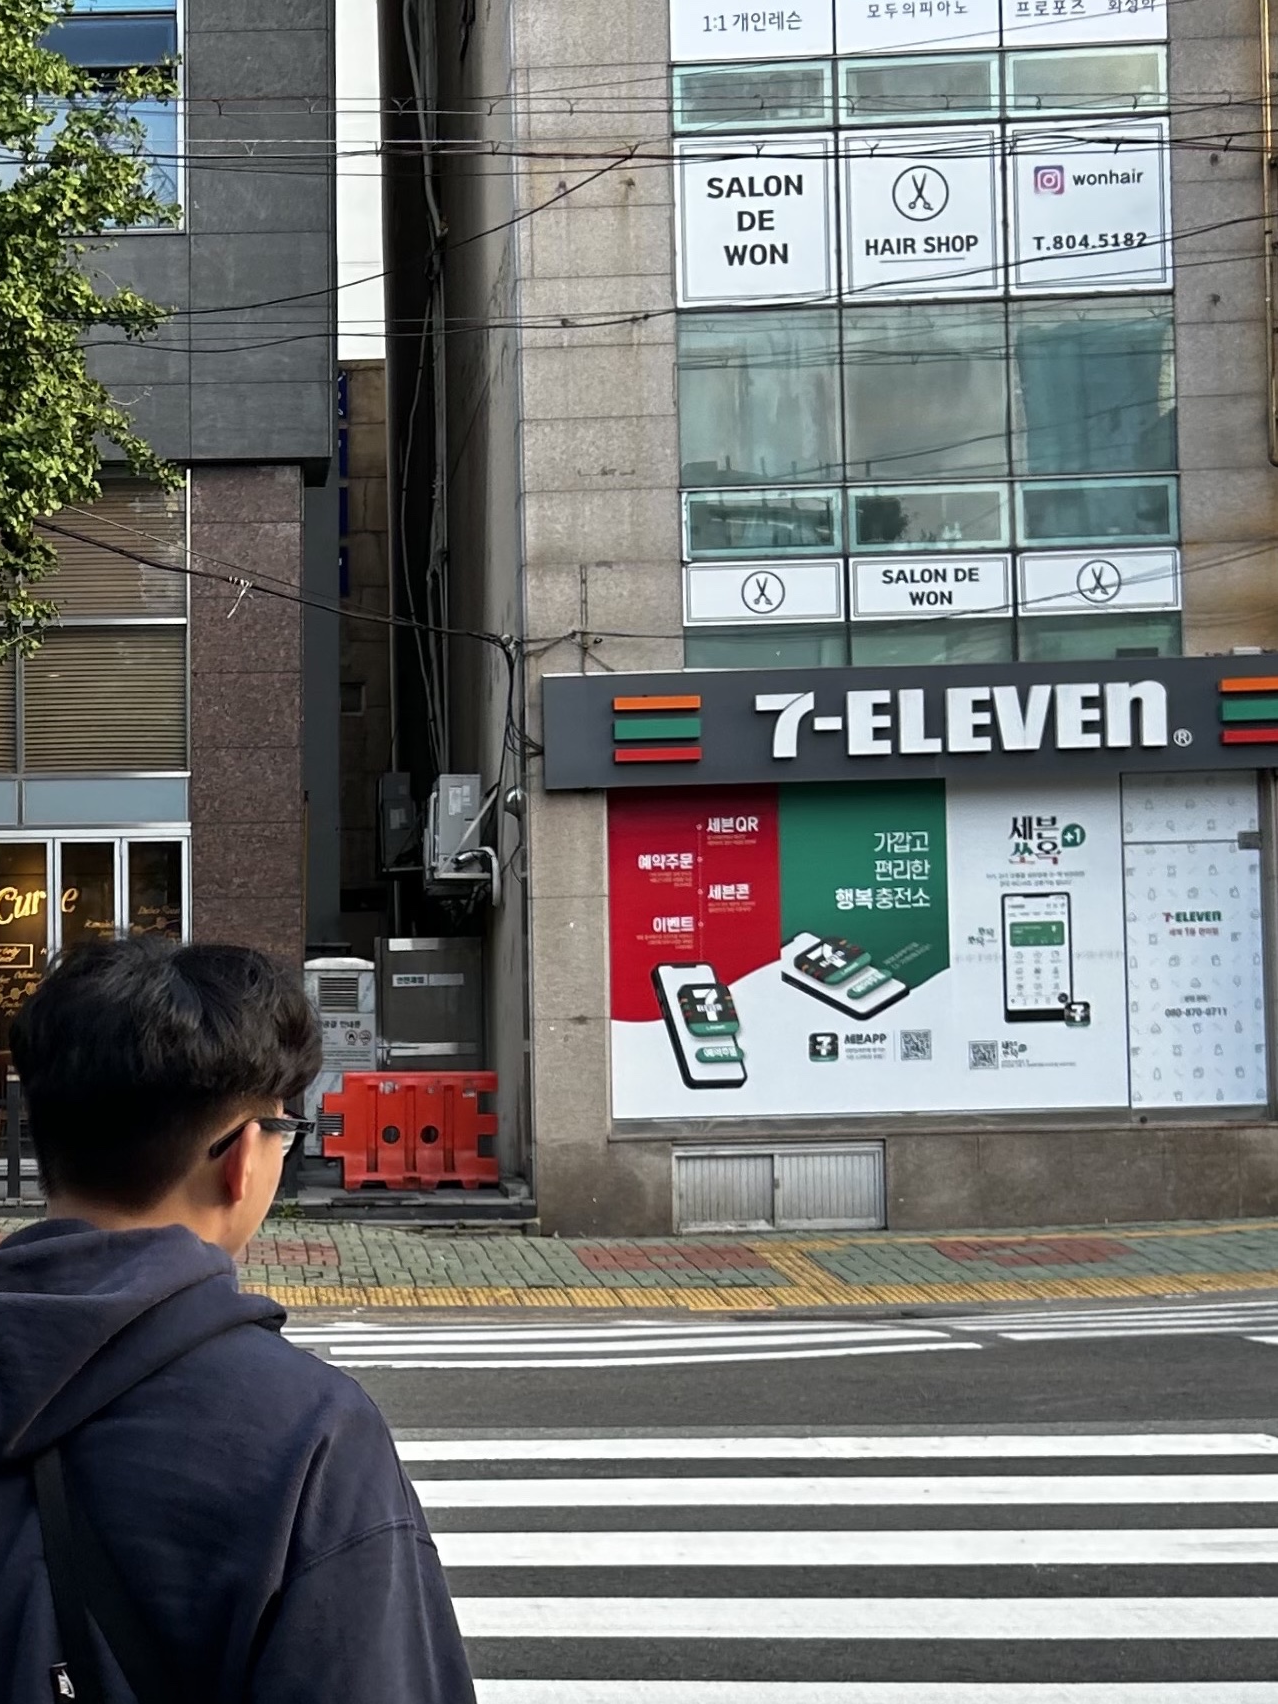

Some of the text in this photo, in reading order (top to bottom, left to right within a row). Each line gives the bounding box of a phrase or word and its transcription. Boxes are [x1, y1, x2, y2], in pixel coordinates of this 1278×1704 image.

[867, 0, 968, 19] 모두의피아노
[702, 11, 803, 32] 1:1 개인레슨
[706, 174, 804, 199] SALON
[1072, 168, 1144, 187] wonhair
[736, 209, 776, 232] DE
[864, 234, 979, 257] HAIR SHOP
[1032, 231, 1148, 252] T.804.5182
[723, 242, 790, 267] WON
[881, 566, 981, 584] SALON DE
[908, 590, 953, 606] WON
[707, 816, 759, 833] 세븐QR
[1008, 815, 1060, 841] 세븐
[874, 831, 930, 853] 가깝고
[637, 853, 694, 870] 예약주문
[875, 858, 931, 881] 편리한
[707, 883, 750, 900] 세븐콘
[835, 886, 931, 910] 행복 충전소
[653, 916, 695, 933] 이벤트
